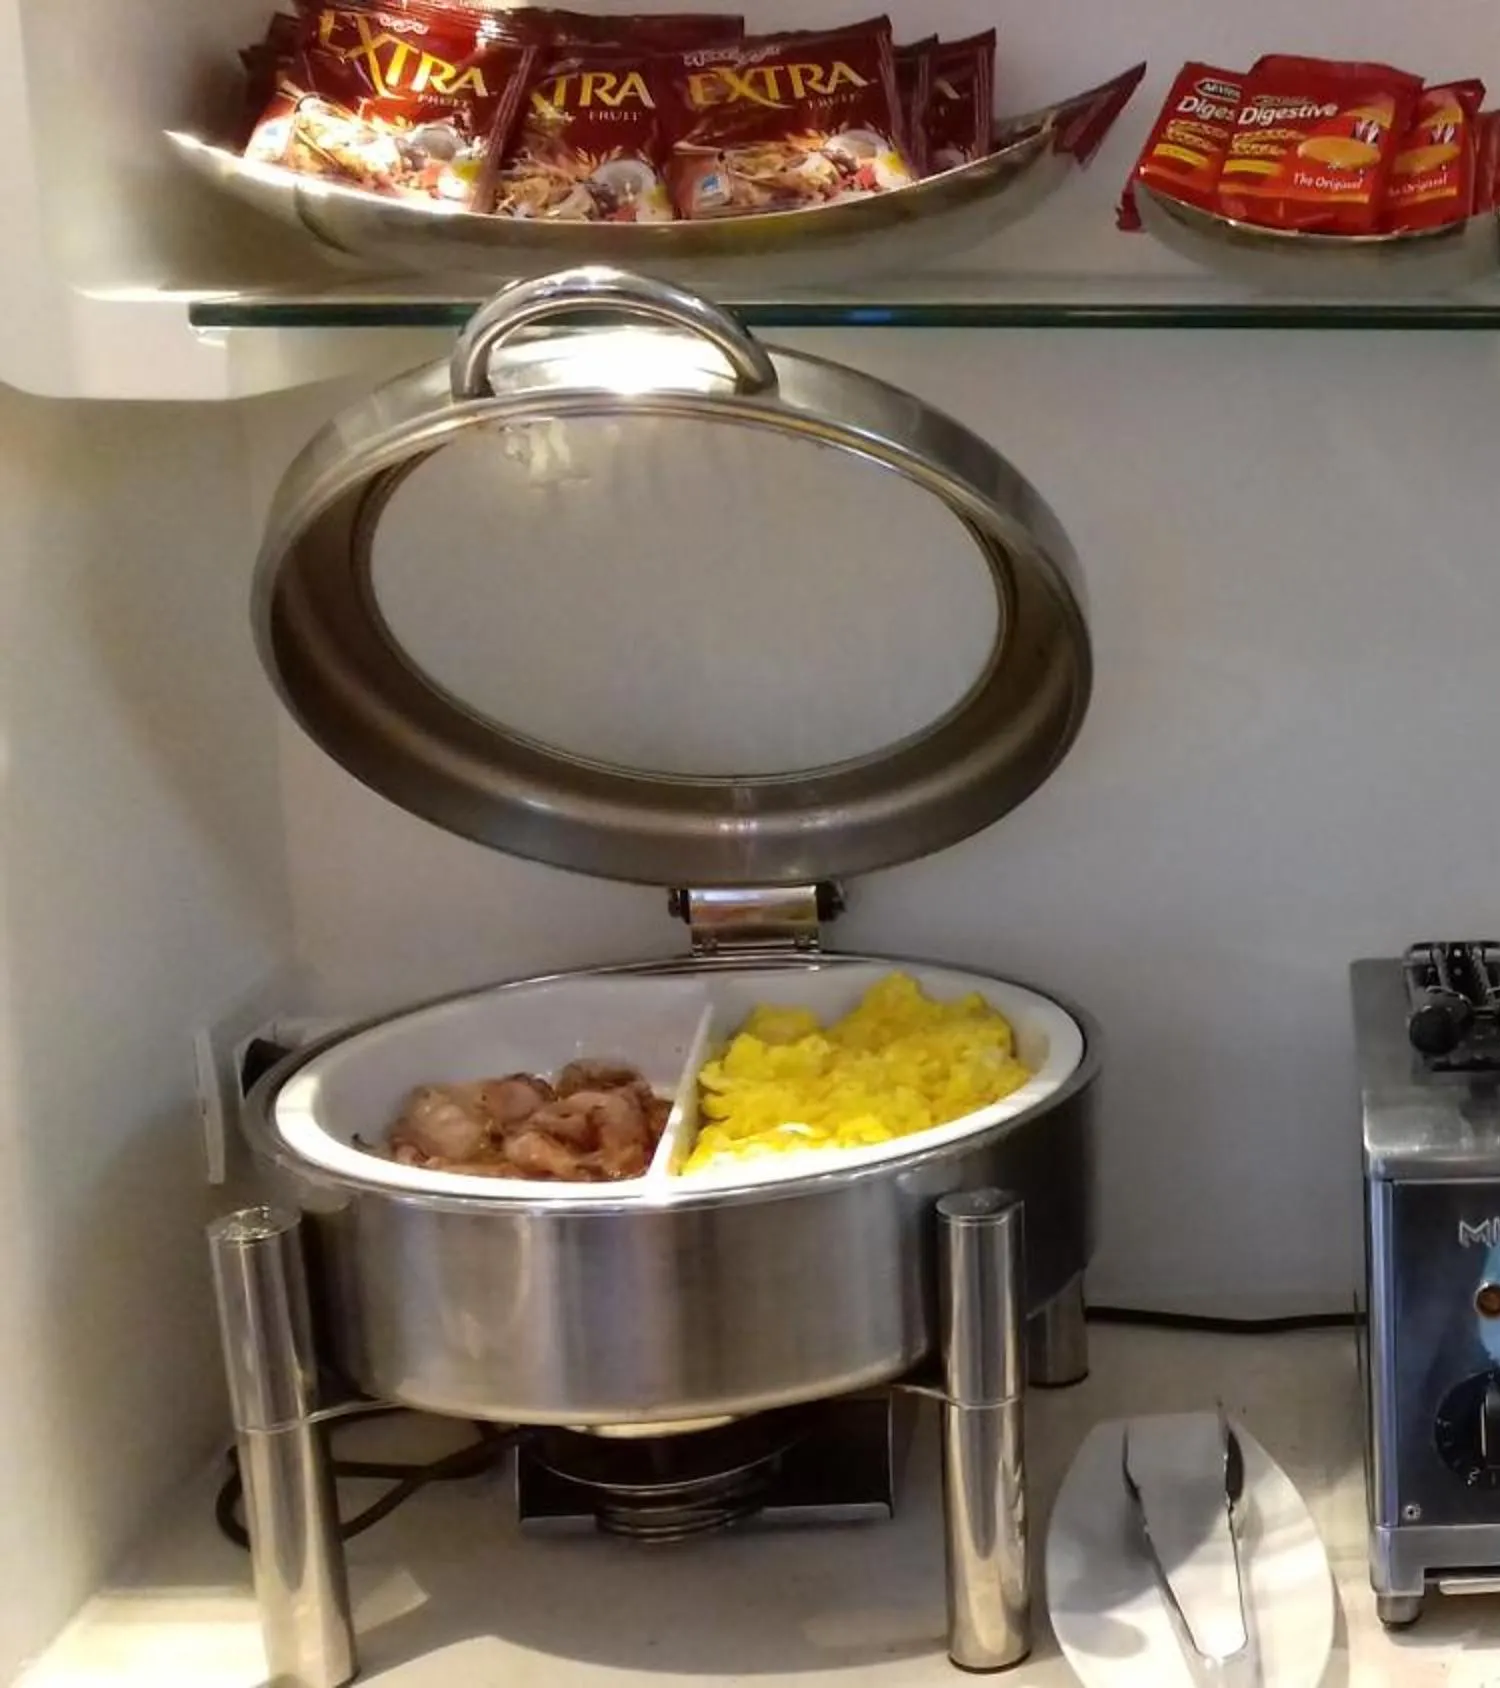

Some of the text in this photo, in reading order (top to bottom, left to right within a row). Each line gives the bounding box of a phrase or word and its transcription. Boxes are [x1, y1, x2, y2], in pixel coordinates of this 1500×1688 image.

[318, 9, 489, 101] EXTRA
[687, 61, 868, 109] EXTRA
[1177, 95, 1236, 121] Diges
[1238, 103, 1339, 127] Digestive
